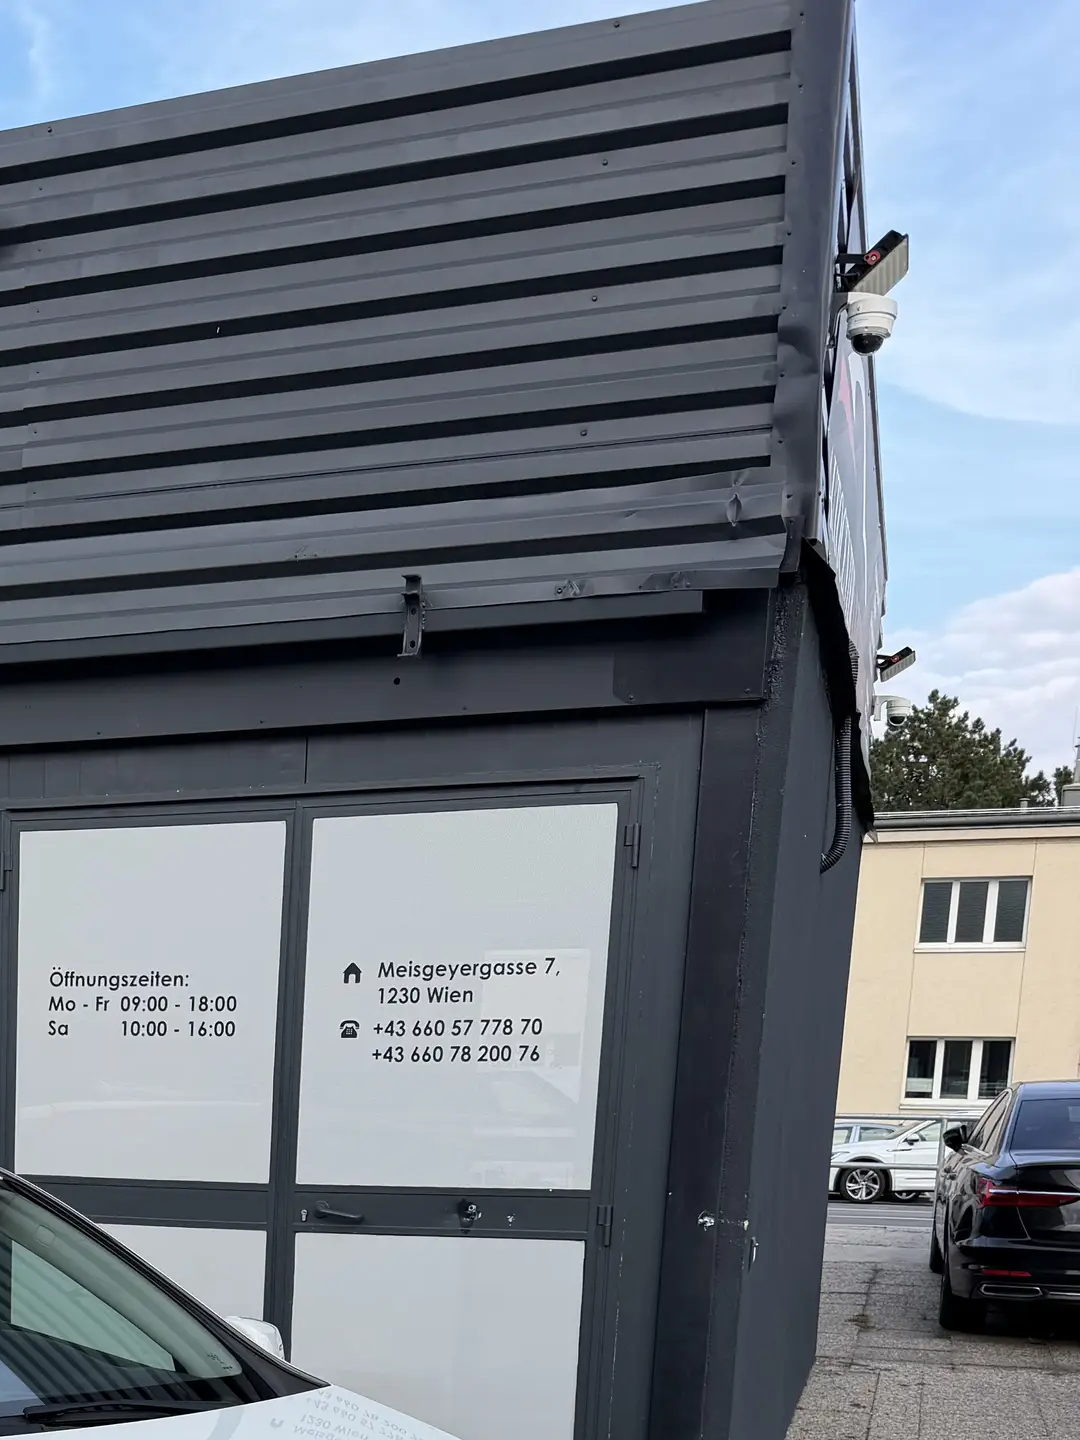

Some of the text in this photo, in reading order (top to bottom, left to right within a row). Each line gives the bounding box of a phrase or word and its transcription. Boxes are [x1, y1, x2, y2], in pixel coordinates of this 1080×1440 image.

[378, 957, 560, 981] Meisgeyergasse 7,
[49, 966, 189, 991] Öffnungszeiten:
[48, 996, 76, 1012] Mo
[95, 996, 110, 1012] Fr
[120, 995, 168, 1012] 09:00
[189, 995, 237, 1012] 18:00
[378, 986, 473, 1004] 1230 Wien
[48, 1020, 69, 1036] Sa
[121, 1020, 167, 1037] 10:00
[188, 1021, 236, 1037] 16:00
[373, 1018, 543, 1037] +43 660 57 778 70
[372, 1045, 540, 1062] +43 660 78 200 76
